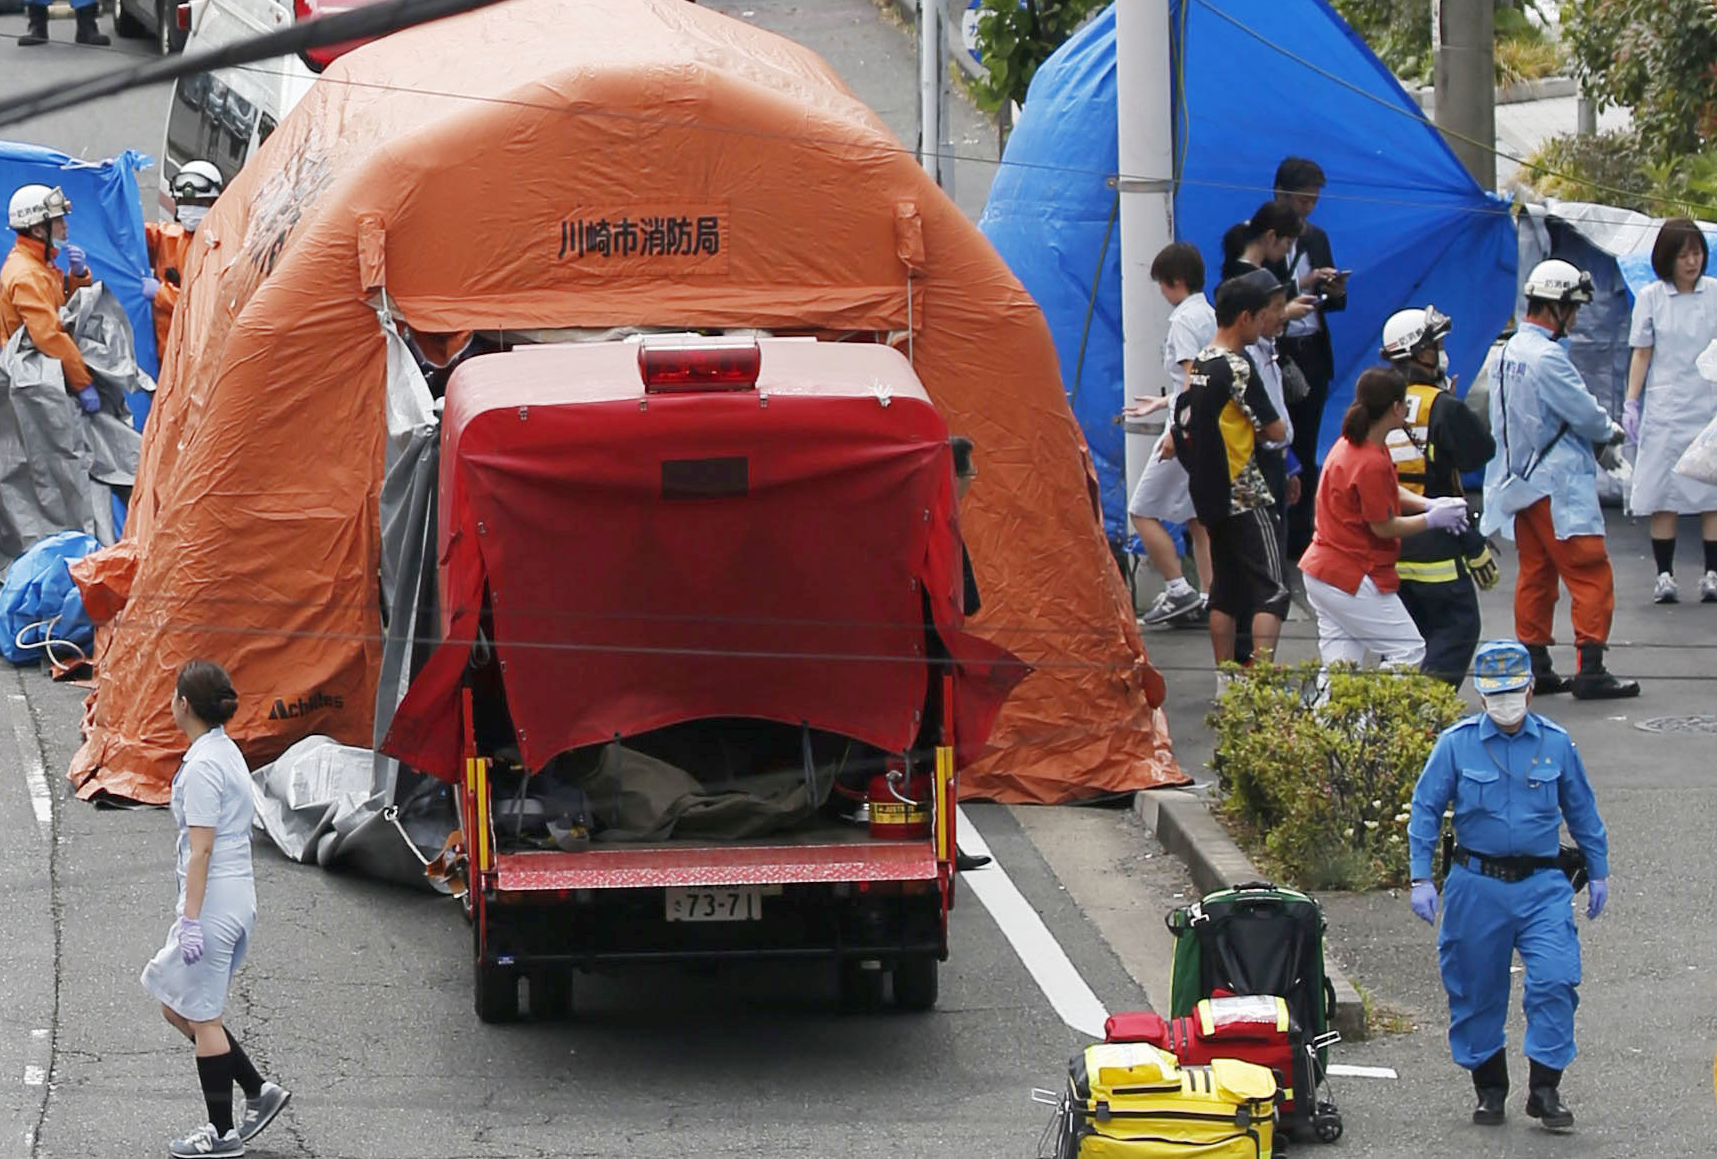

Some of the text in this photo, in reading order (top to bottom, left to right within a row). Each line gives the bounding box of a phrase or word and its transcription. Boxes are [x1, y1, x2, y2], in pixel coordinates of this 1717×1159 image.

[558, 216, 720, 260] 川崎市消防局
